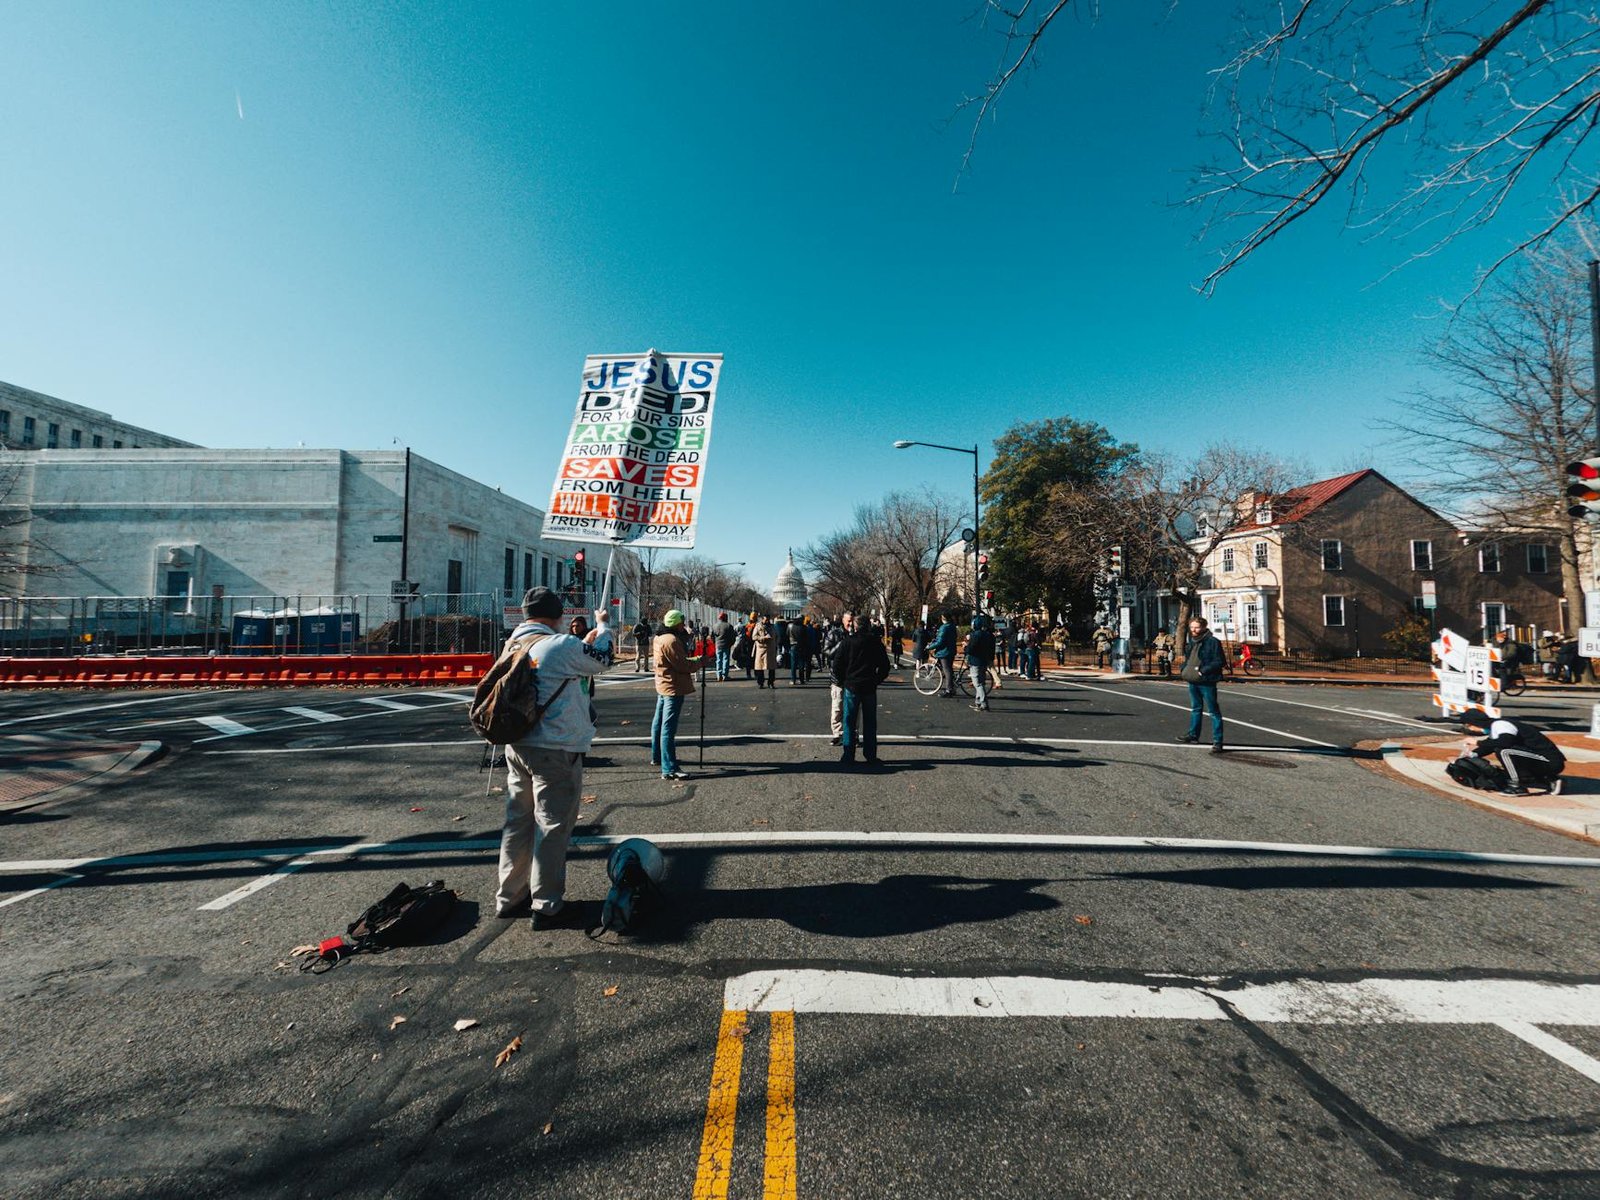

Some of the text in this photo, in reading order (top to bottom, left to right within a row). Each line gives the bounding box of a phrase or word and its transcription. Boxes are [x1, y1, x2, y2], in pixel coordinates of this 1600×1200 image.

[587, 358, 715, 391] JESUS
[585, 388, 705, 414] DIED
[580, 408, 705, 428] FOR YOUR SINS
[577, 423, 701, 449] AROSE
[570, 443, 700, 463] FROM THE DEAD
[566, 458, 695, 486] SAVES
[560, 479, 693, 501] FROM HELL
[559, 494, 689, 524] WILL RETURN
[551, 515, 690, 536] TRUST HIM TODAY
[1470, 669, 1484, 685] 15
